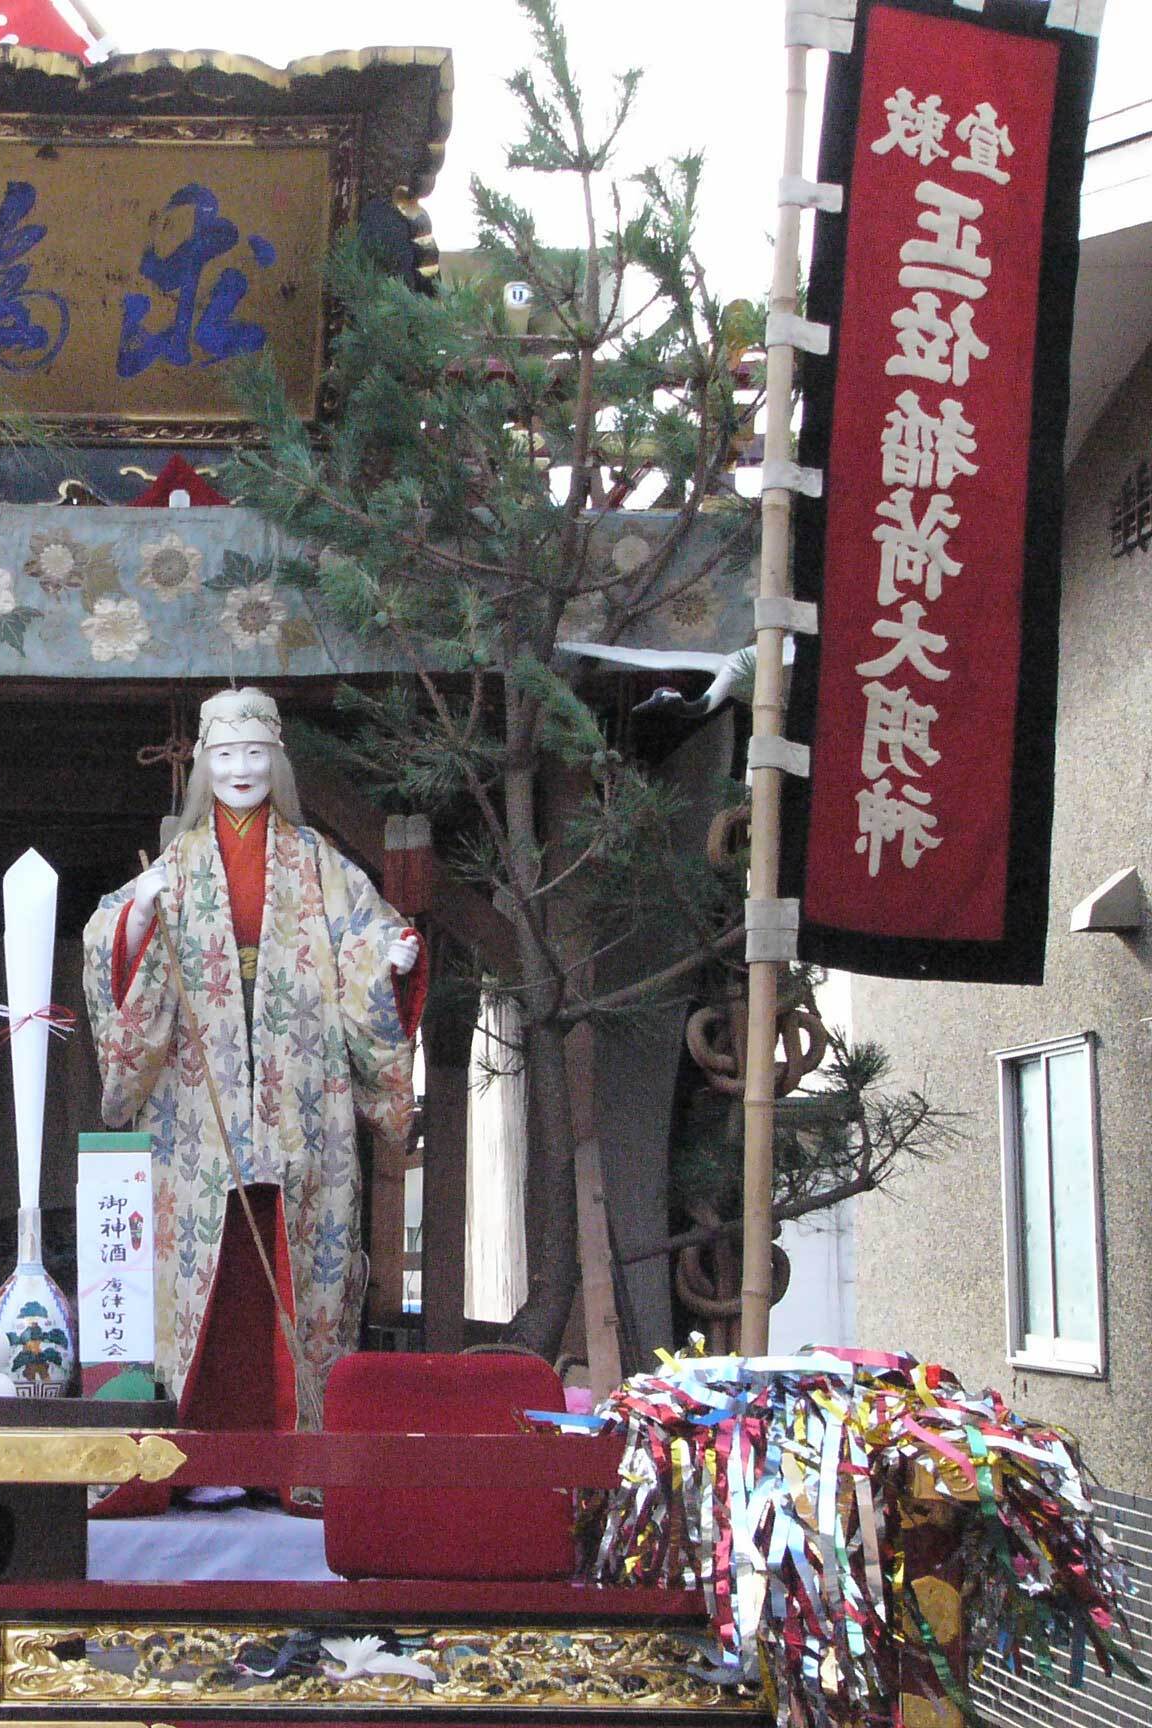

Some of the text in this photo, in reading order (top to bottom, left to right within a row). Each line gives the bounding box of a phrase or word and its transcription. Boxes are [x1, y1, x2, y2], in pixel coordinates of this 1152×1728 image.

[98, 1194, 128, 1264] 御神酒
[100, 1277, 128, 1356] 唐津町内会
